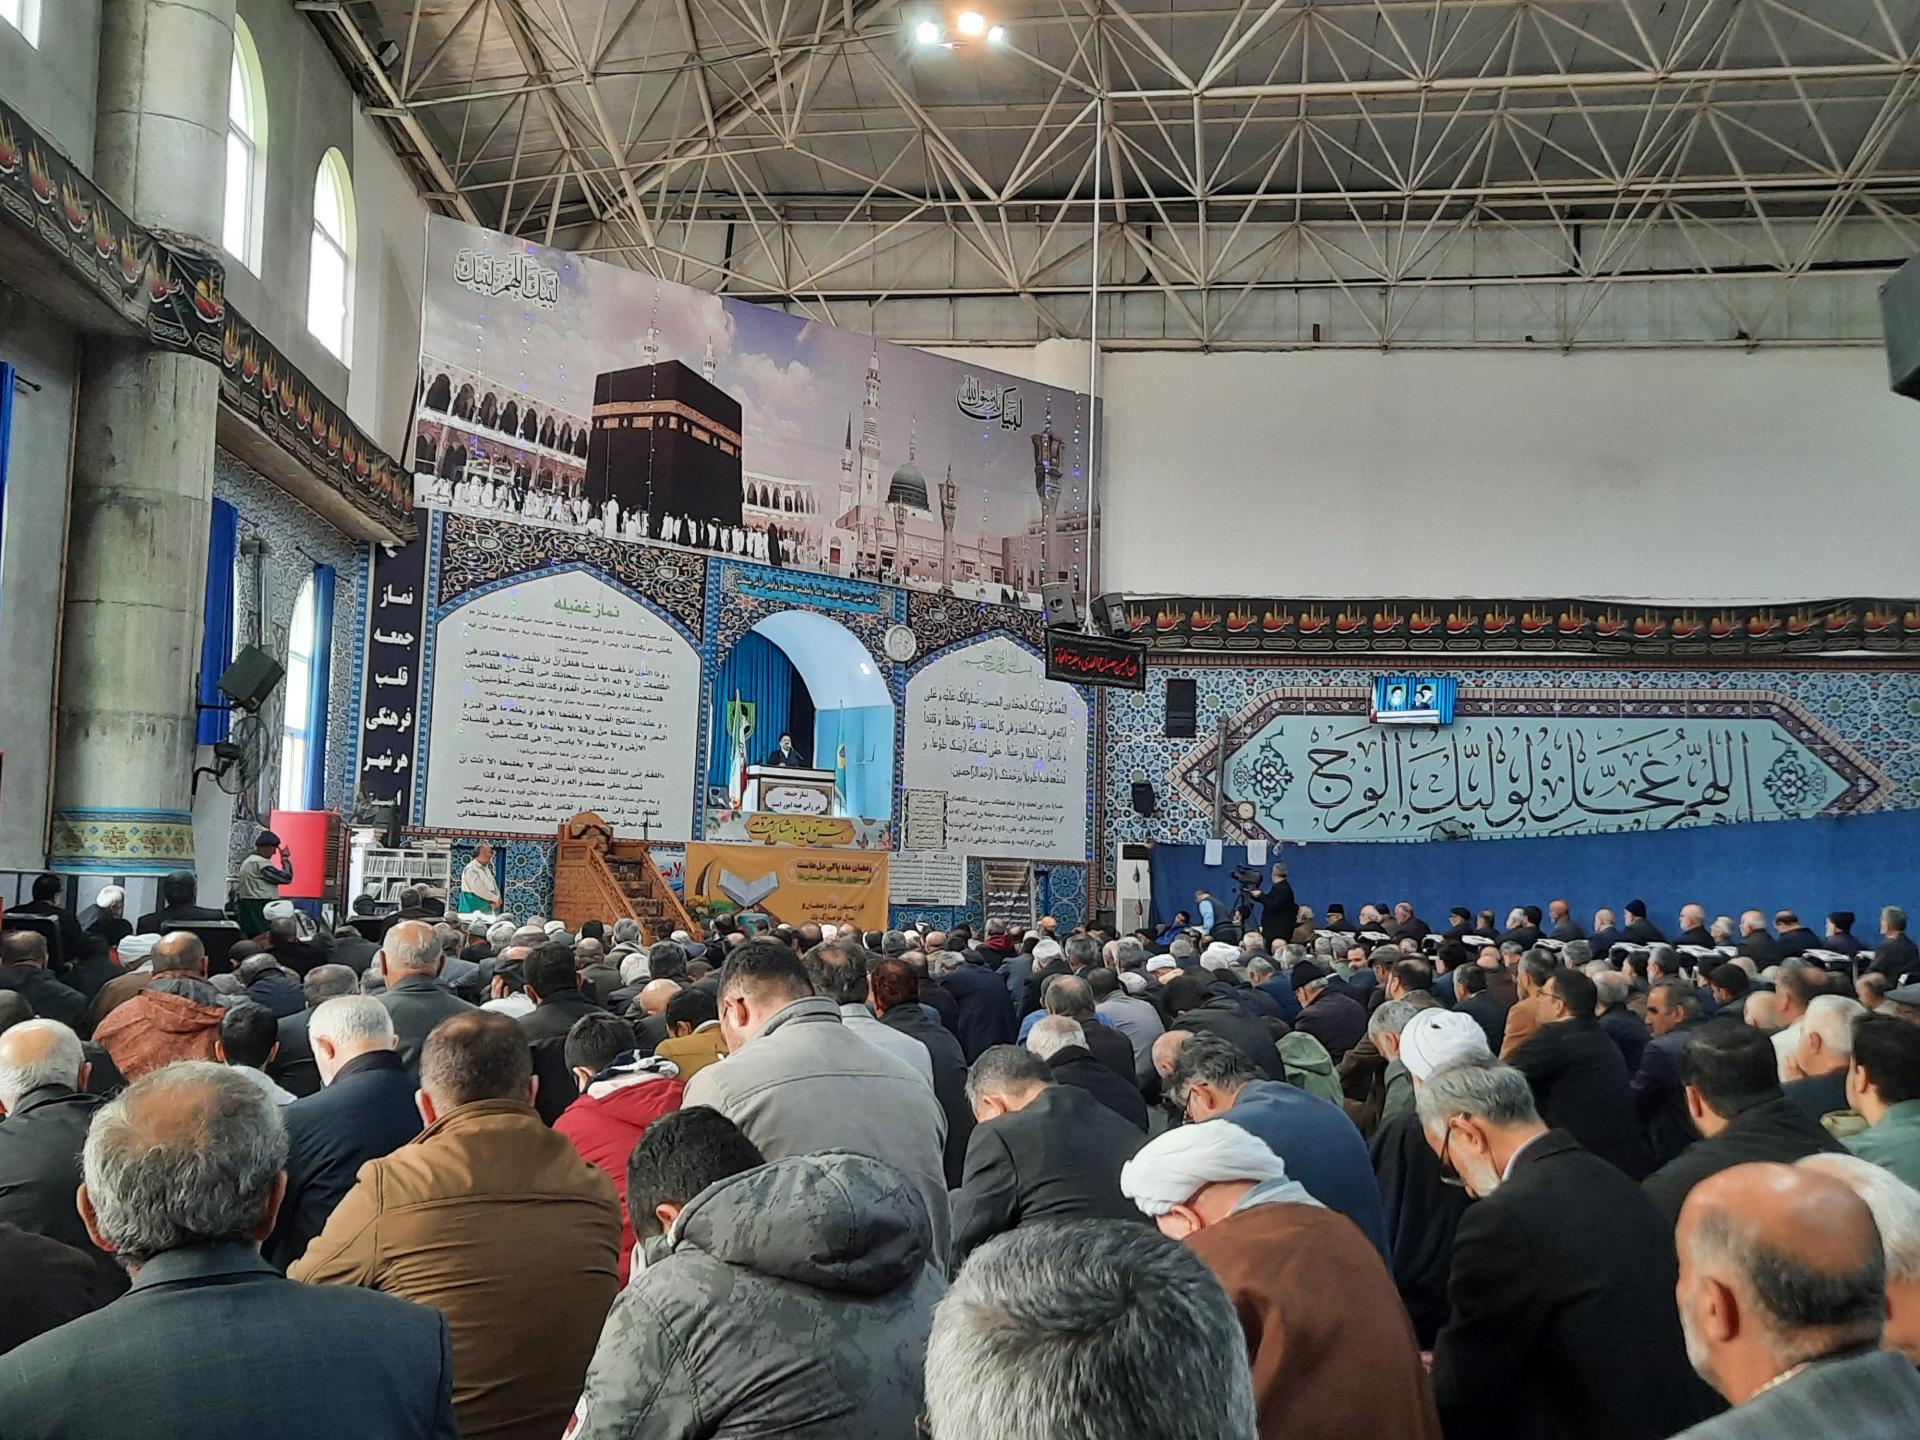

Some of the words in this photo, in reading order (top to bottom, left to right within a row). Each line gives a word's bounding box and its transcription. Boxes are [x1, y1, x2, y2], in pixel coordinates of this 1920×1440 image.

[379, 584, 413, 607] نماز
[554, 598, 592, 615] غفیله
[593, 603, 620, 618] نماز
[374, 628, 414, 650] جمعه
[375, 667, 408, 688] قلب
[366, 707, 412, 732] فرهنگی
[363, 748, 392, 772] شهر
[393, 753, 408, 773] هر
